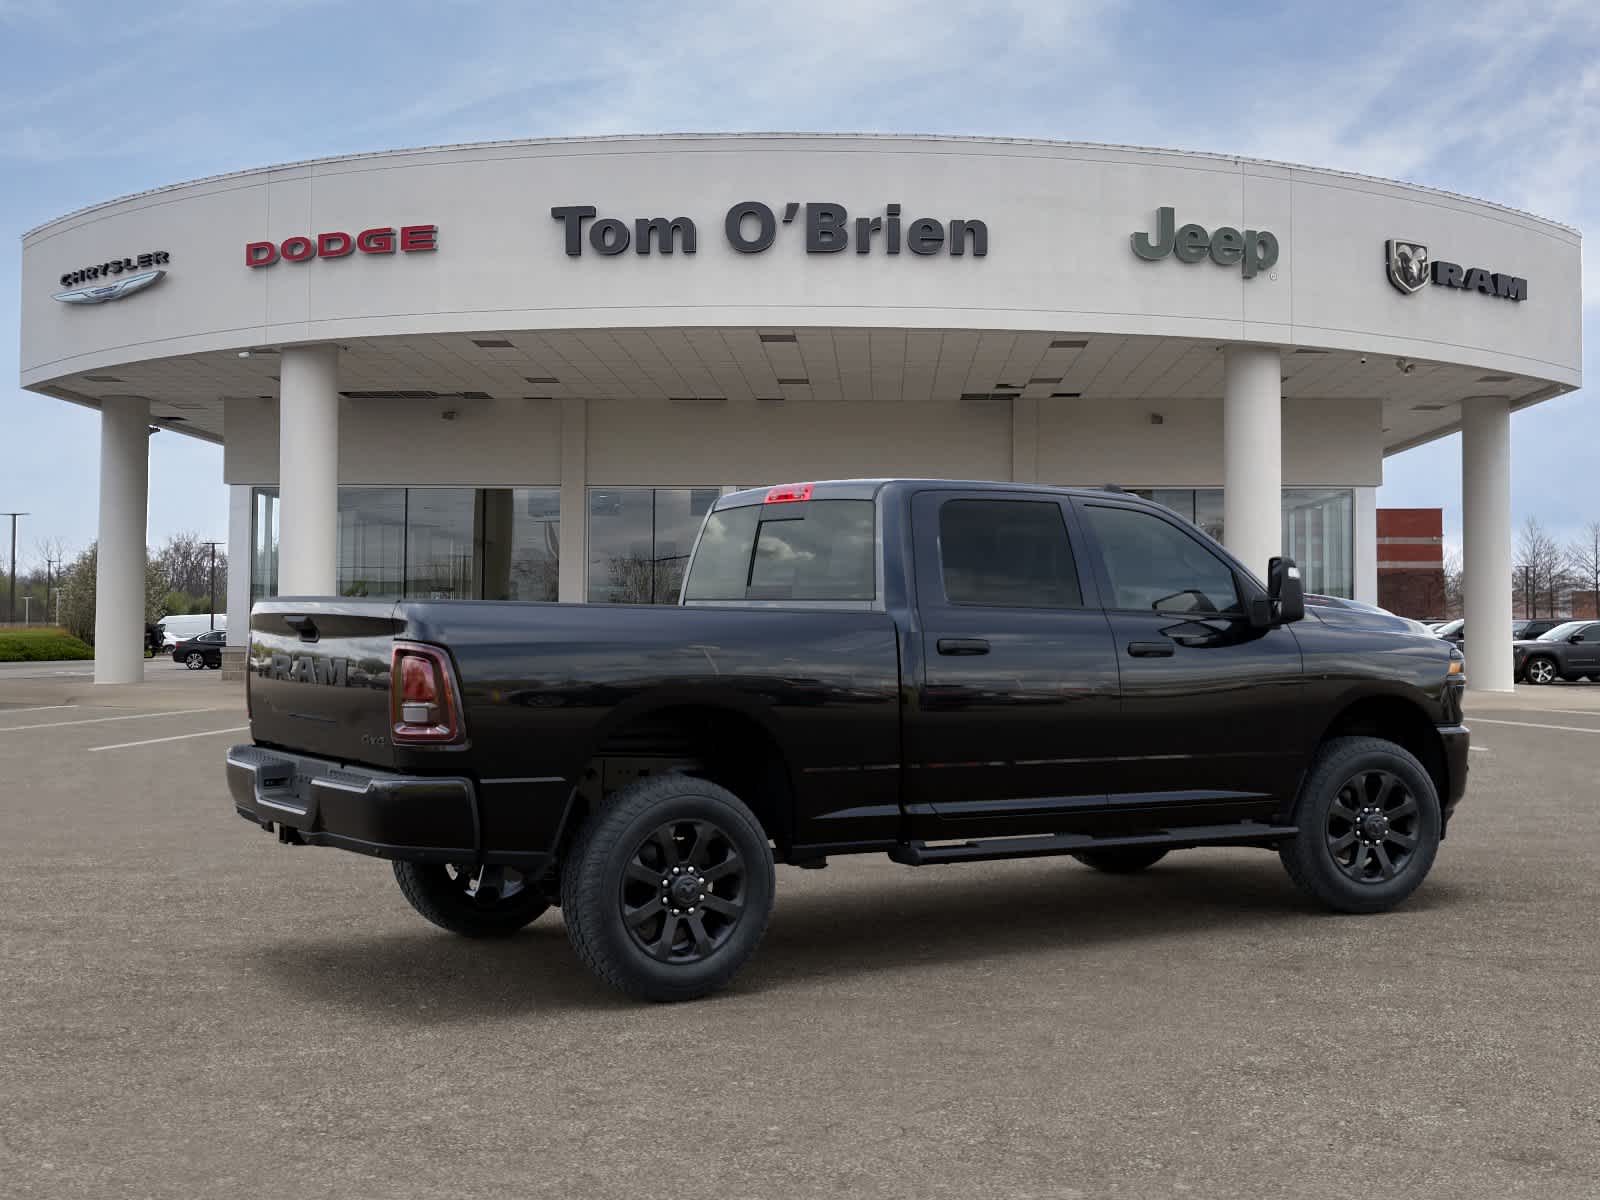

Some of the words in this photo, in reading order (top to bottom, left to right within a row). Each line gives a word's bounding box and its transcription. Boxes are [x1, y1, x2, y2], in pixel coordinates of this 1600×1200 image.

[245, 224, 440, 269] DODGE
[551, 205, 697, 257] Tom
[724, 201, 989, 257] O'Brien
[1129, 206, 1280, 280] Jeep
[60, 250, 171, 287] CHRYSLER
[1430, 260, 1528, 302] RAM
[270, 654, 350, 688] RAM
